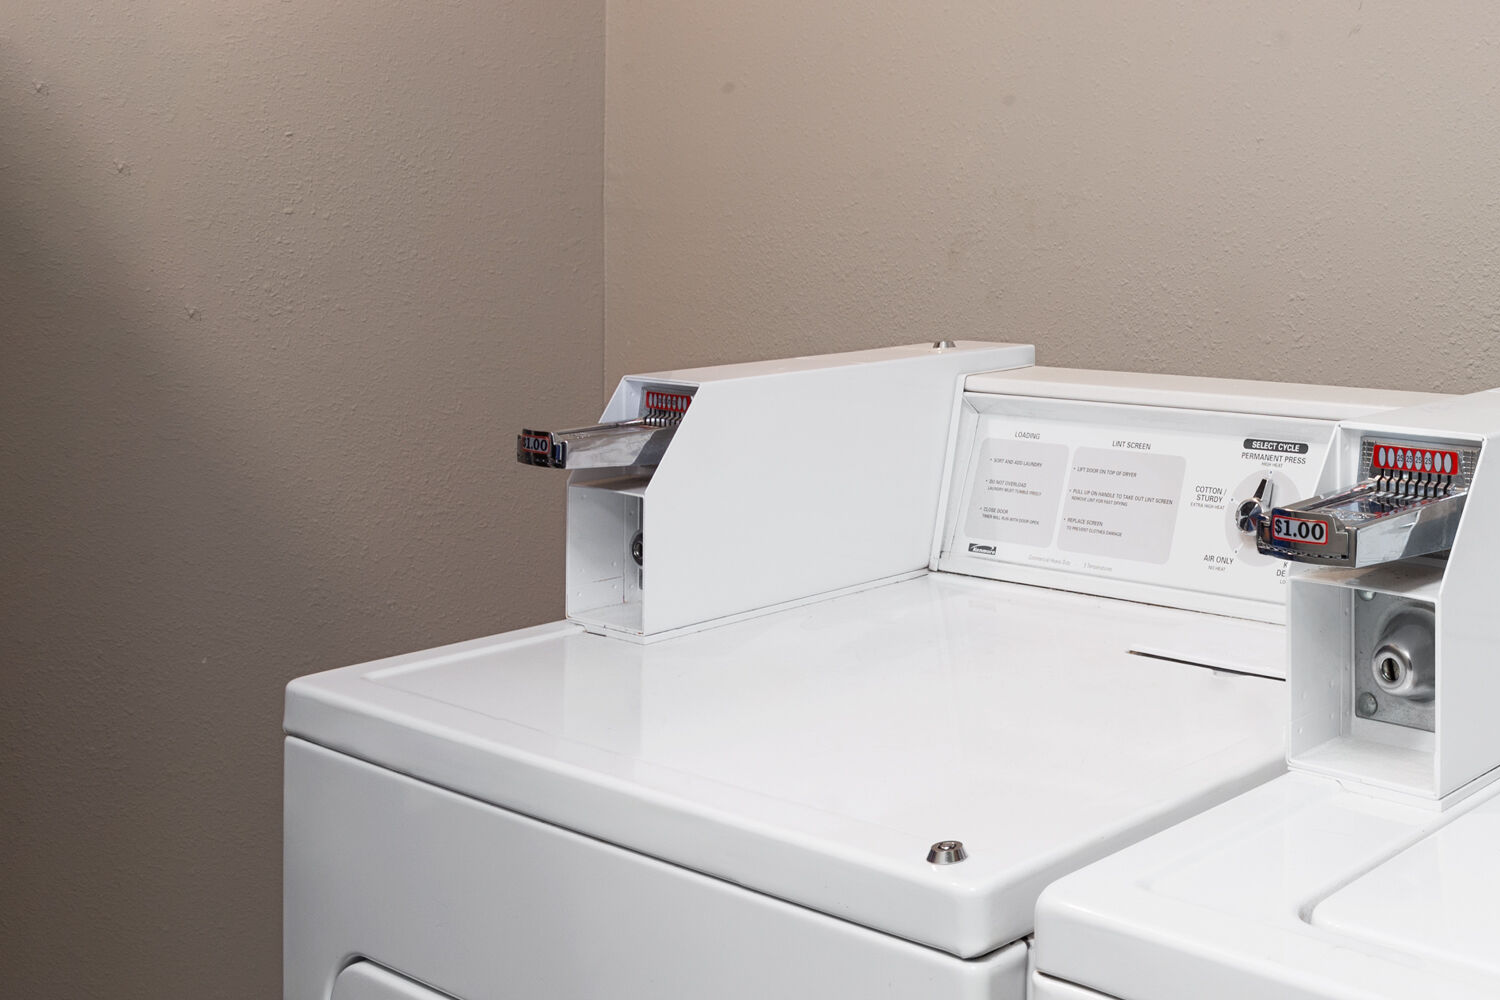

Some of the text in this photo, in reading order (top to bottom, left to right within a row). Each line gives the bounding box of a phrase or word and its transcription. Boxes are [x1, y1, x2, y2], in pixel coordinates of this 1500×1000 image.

[1014, 432, 1040, 440] LOADING
[1127, 442, 1151, 450] SCREEN
[1252, 441, 1299, 452] SELECT CYCLE
[1241, 452, 1306, 464] PERMANENT PRESS
[1195, 486, 1223, 495] COTTON
[1196, 494, 1223, 503] STURDY
[1274, 519, 1324, 540] $1.00
[1216, 556, 1234, 564] ONLY
